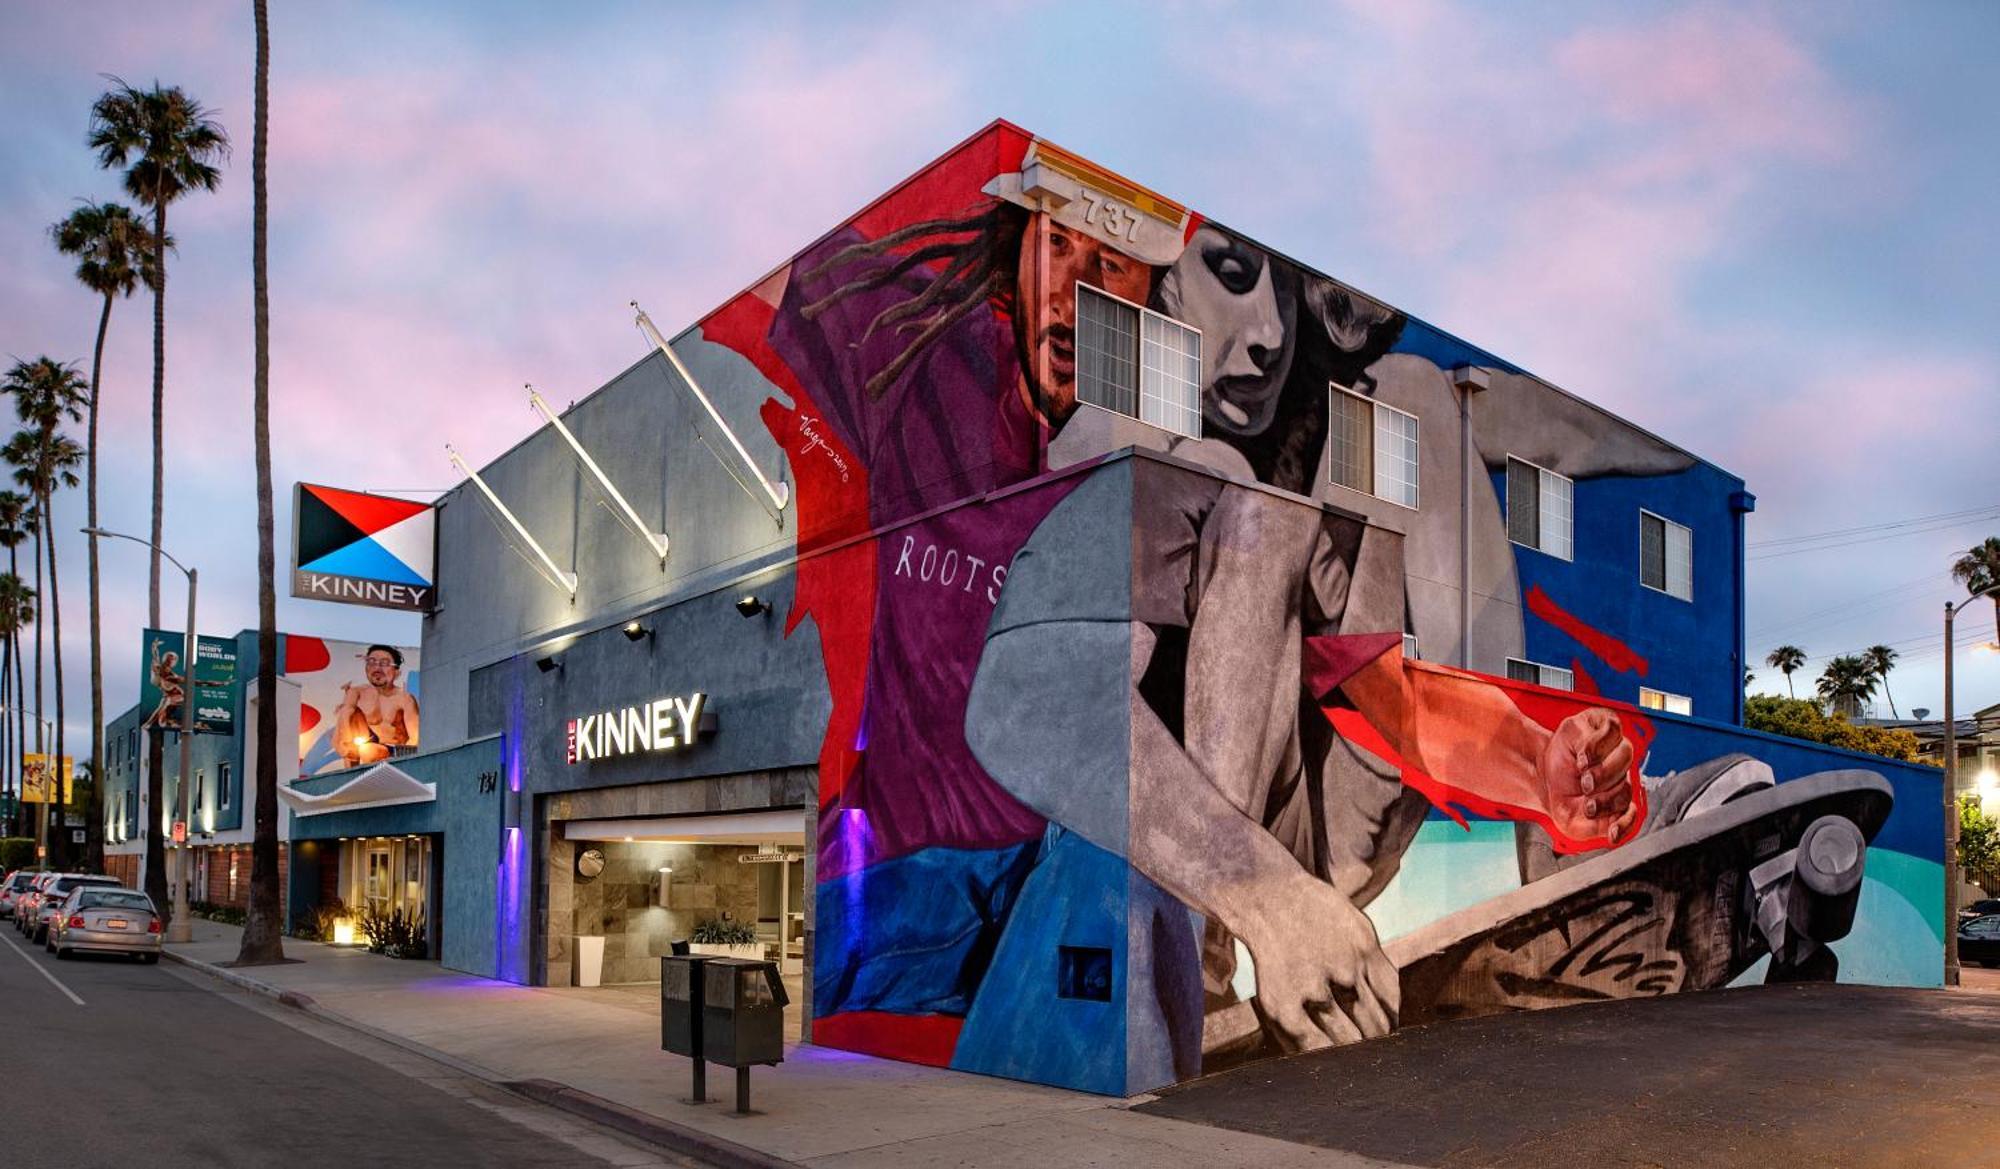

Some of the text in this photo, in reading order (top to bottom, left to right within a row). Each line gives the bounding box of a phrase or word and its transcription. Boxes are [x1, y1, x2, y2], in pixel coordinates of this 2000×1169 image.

[1080, 188, 1144, 244] 737
[311, 574, 427, 606] KINNEY
[895, 535, 1008, 605] ROOTS
[567, 692, 702, 765] THE KINNEY
